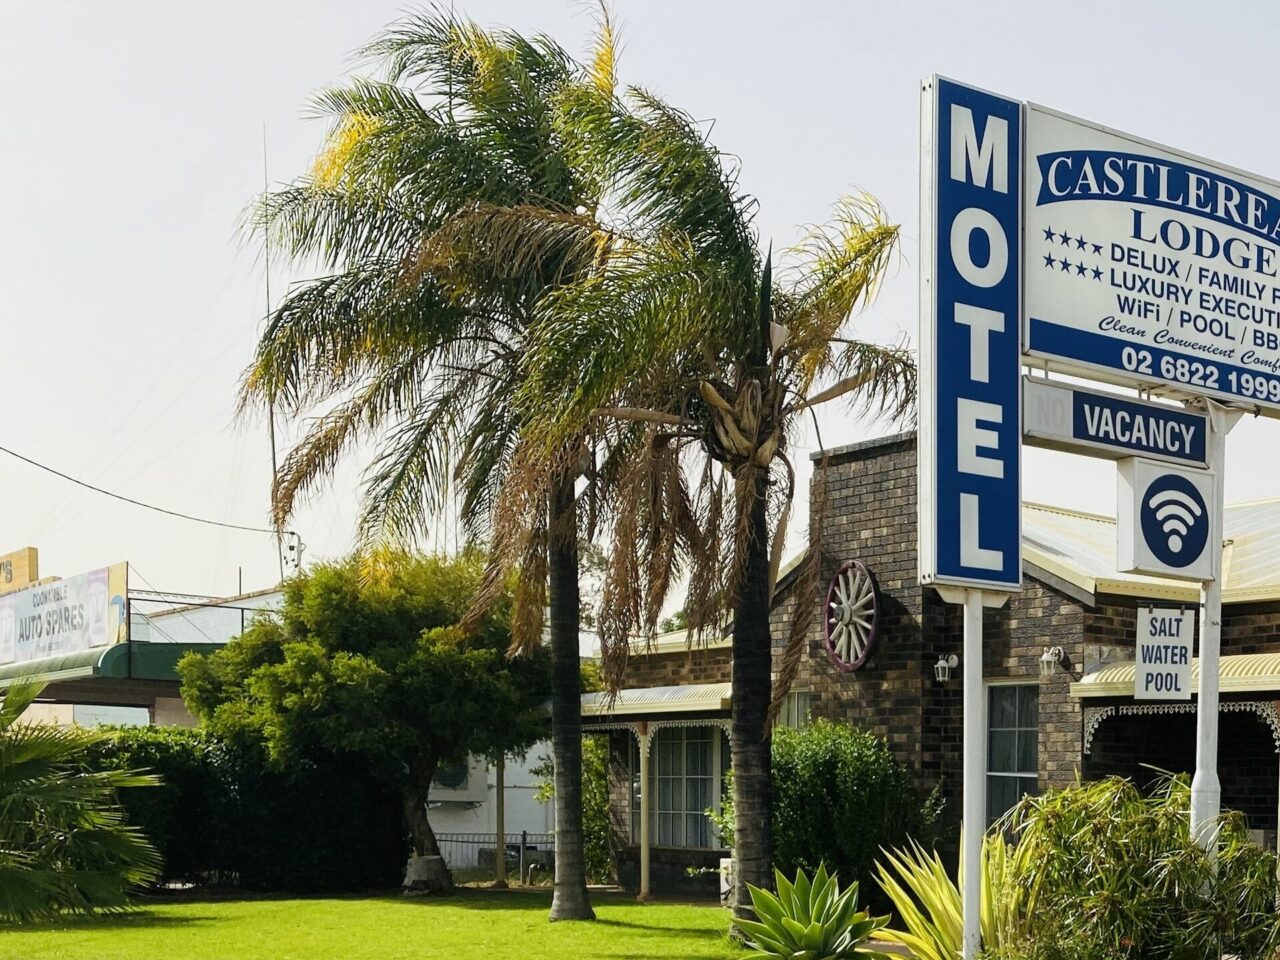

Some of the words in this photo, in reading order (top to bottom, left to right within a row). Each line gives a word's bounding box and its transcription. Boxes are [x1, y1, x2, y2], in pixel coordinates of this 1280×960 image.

[1130, 208, 1278, 278] LODGE
[1110, 242, 1181, 278] DELUX
[1184, 263, 1193, 283] /
[1198, 266, 1267, 301] FAMILY
[1110, 267, 1193, 306] LUXURY
[949, 102, 1009, 573] MOTEL
[1098, 315, 1147, 338] Clean
[1153, 328, 1235, 360] Convenient
[1116, 294, 1161, 322] WiFi
[1165, 307, 1174, 327] /
[1180, 311, 1236, 344] POOL
[1240, 326, 1247, 345] /
[1121, 346, 1153, 375] 02
[1160, 357, 1219, 390] 6822
[1083, 403, 1195, 454] VACANCY
[18, 613, 43, 643] AUTO
[45, 603, 84, 636] SPARES
[1149, 616, 1182, 639] SALT
[1141, 644, 1188, 666] WATER
[1145, 671, 1181, 693] POOL
